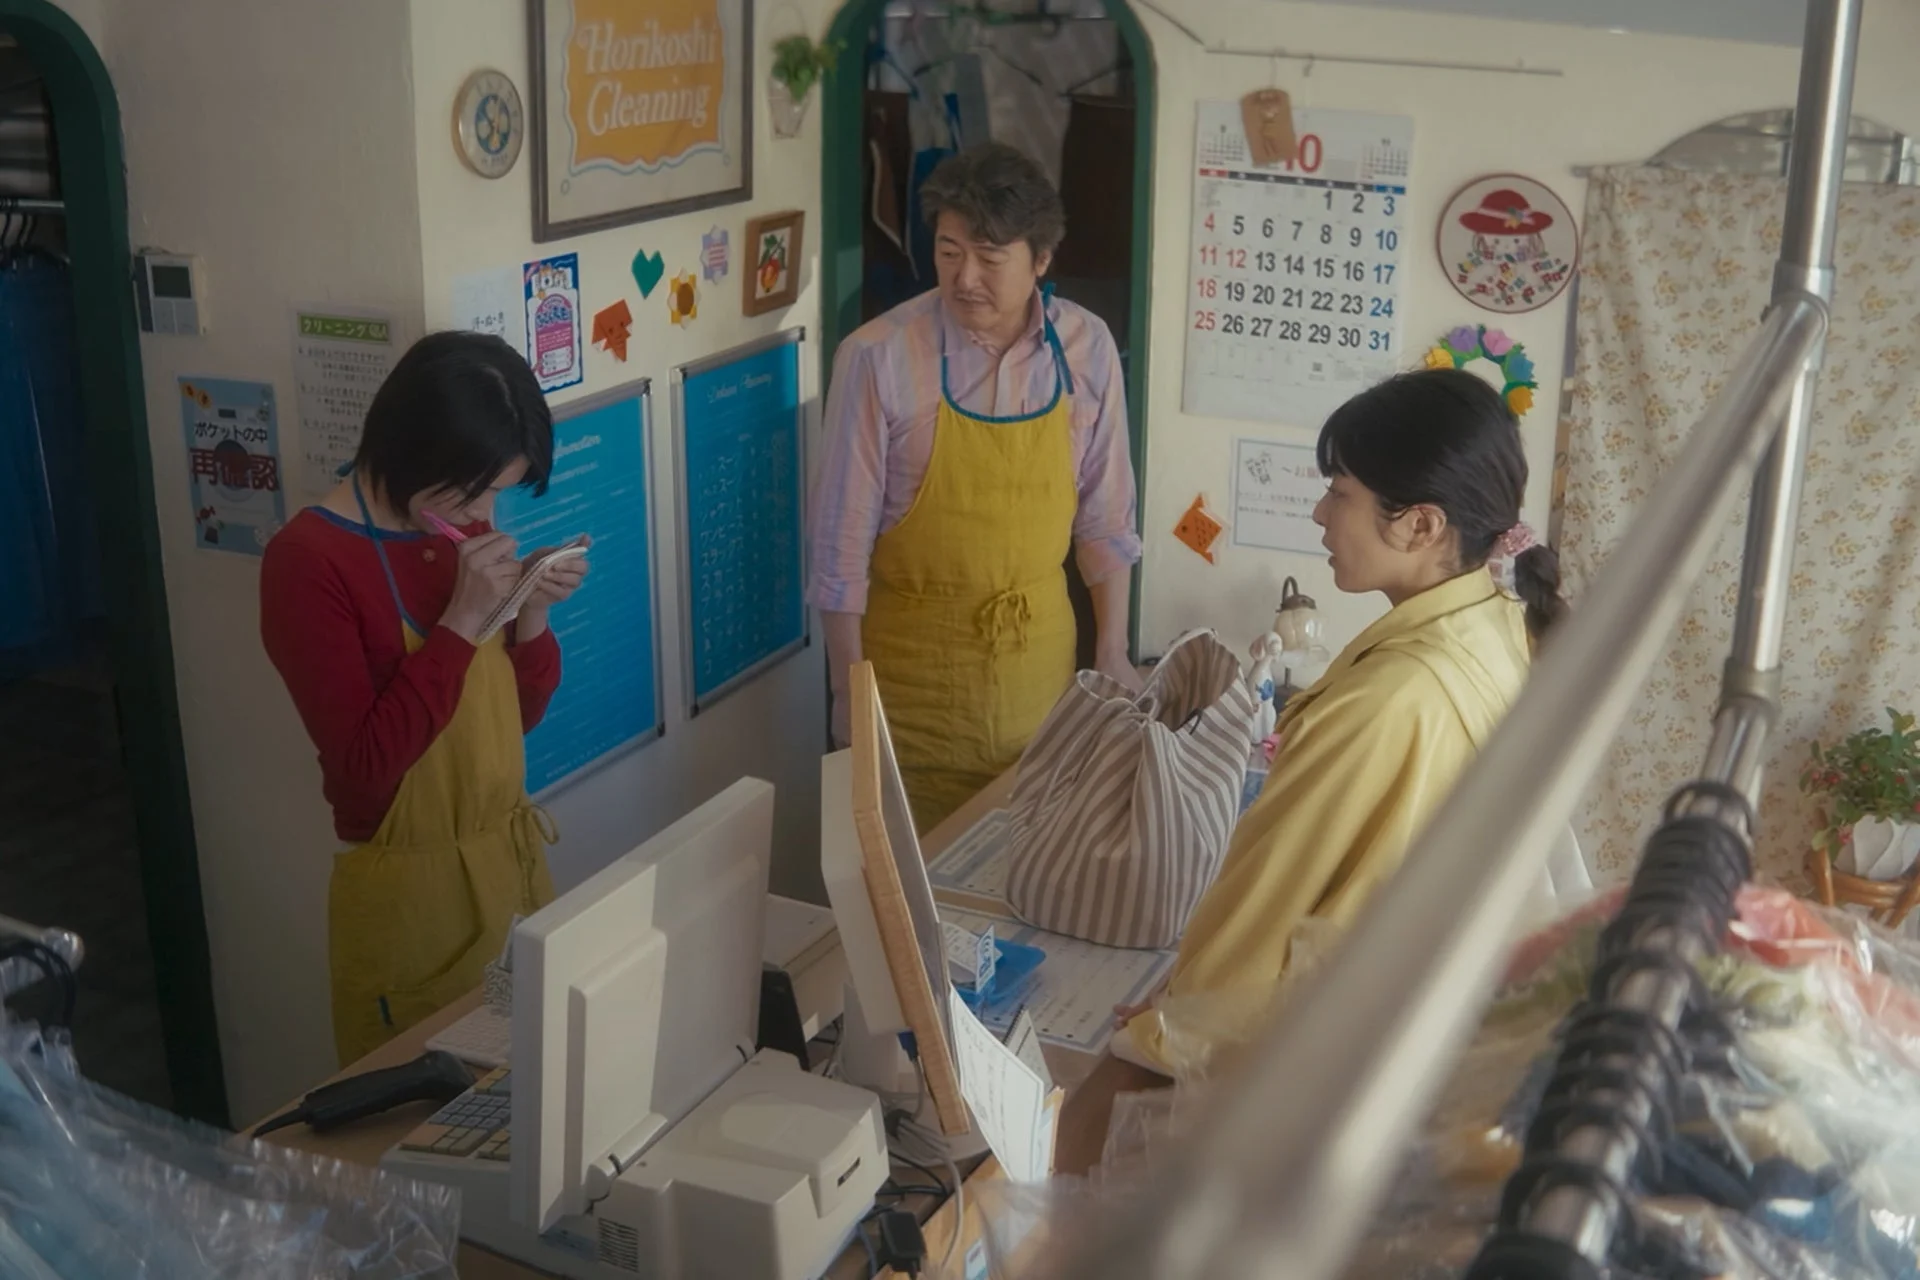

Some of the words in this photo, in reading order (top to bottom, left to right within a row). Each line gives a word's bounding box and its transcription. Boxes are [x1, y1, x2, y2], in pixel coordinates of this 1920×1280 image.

[577, 17, 719, 75] Horikoshi
[586, 79, 712, 137] Cleaning
[1285, 133, 1323, 173] 0
[1323, 190, 1332, 210] 1
[1352, 193, 1364, 213] 2
[1383, 196, 1395, 216] 3
[1204, 213, 1215, 232] 4
[1233, 216, 1244, 235] 5
[1262, 218, 1274, 238] 6
[1291, 221, 1303, 241] 7
[1320, 224, 1332, 244] 8
[1350, 228, 1361, 247] 9
[1375, 230, 1397, 251] 10
[1200, 245, 1217, 266] 11
[1226, 249, 1246, 268] 12
[1255, 252, 1276, 272] 13
[1284, 255, 1304, 275] 14
[1313, 258, 1334, 278] 15
[1343, 261, 1364, 282] 16
[1373, 264, 1395, 284] 17
[1197, 279, 1216, 298] 18
[1224, 282, 1245, 302] 19
[1253, 285, 1275, 305] 20
[1283, 288, 1303, 308] 21
[1311, 291, 1333, 311] 22
[1340, 294, 1363, 314] 23
[1370, 297, 1393, 318] 24
[303, 318, 367, 339] クリーニング
[1195, 310, 1215, 330] 25
[1222, 314, 1244, 334] 26
[1250, 317, 1273, 337] 27
[1279, 320, 1301, 341] 28
[1308, 323, 1331, 344] 29
[1338, 327, 1361, 348] 30
[1368, 330, 1391, 351] 31
[194, 421, 268, 443] ポケットの中
